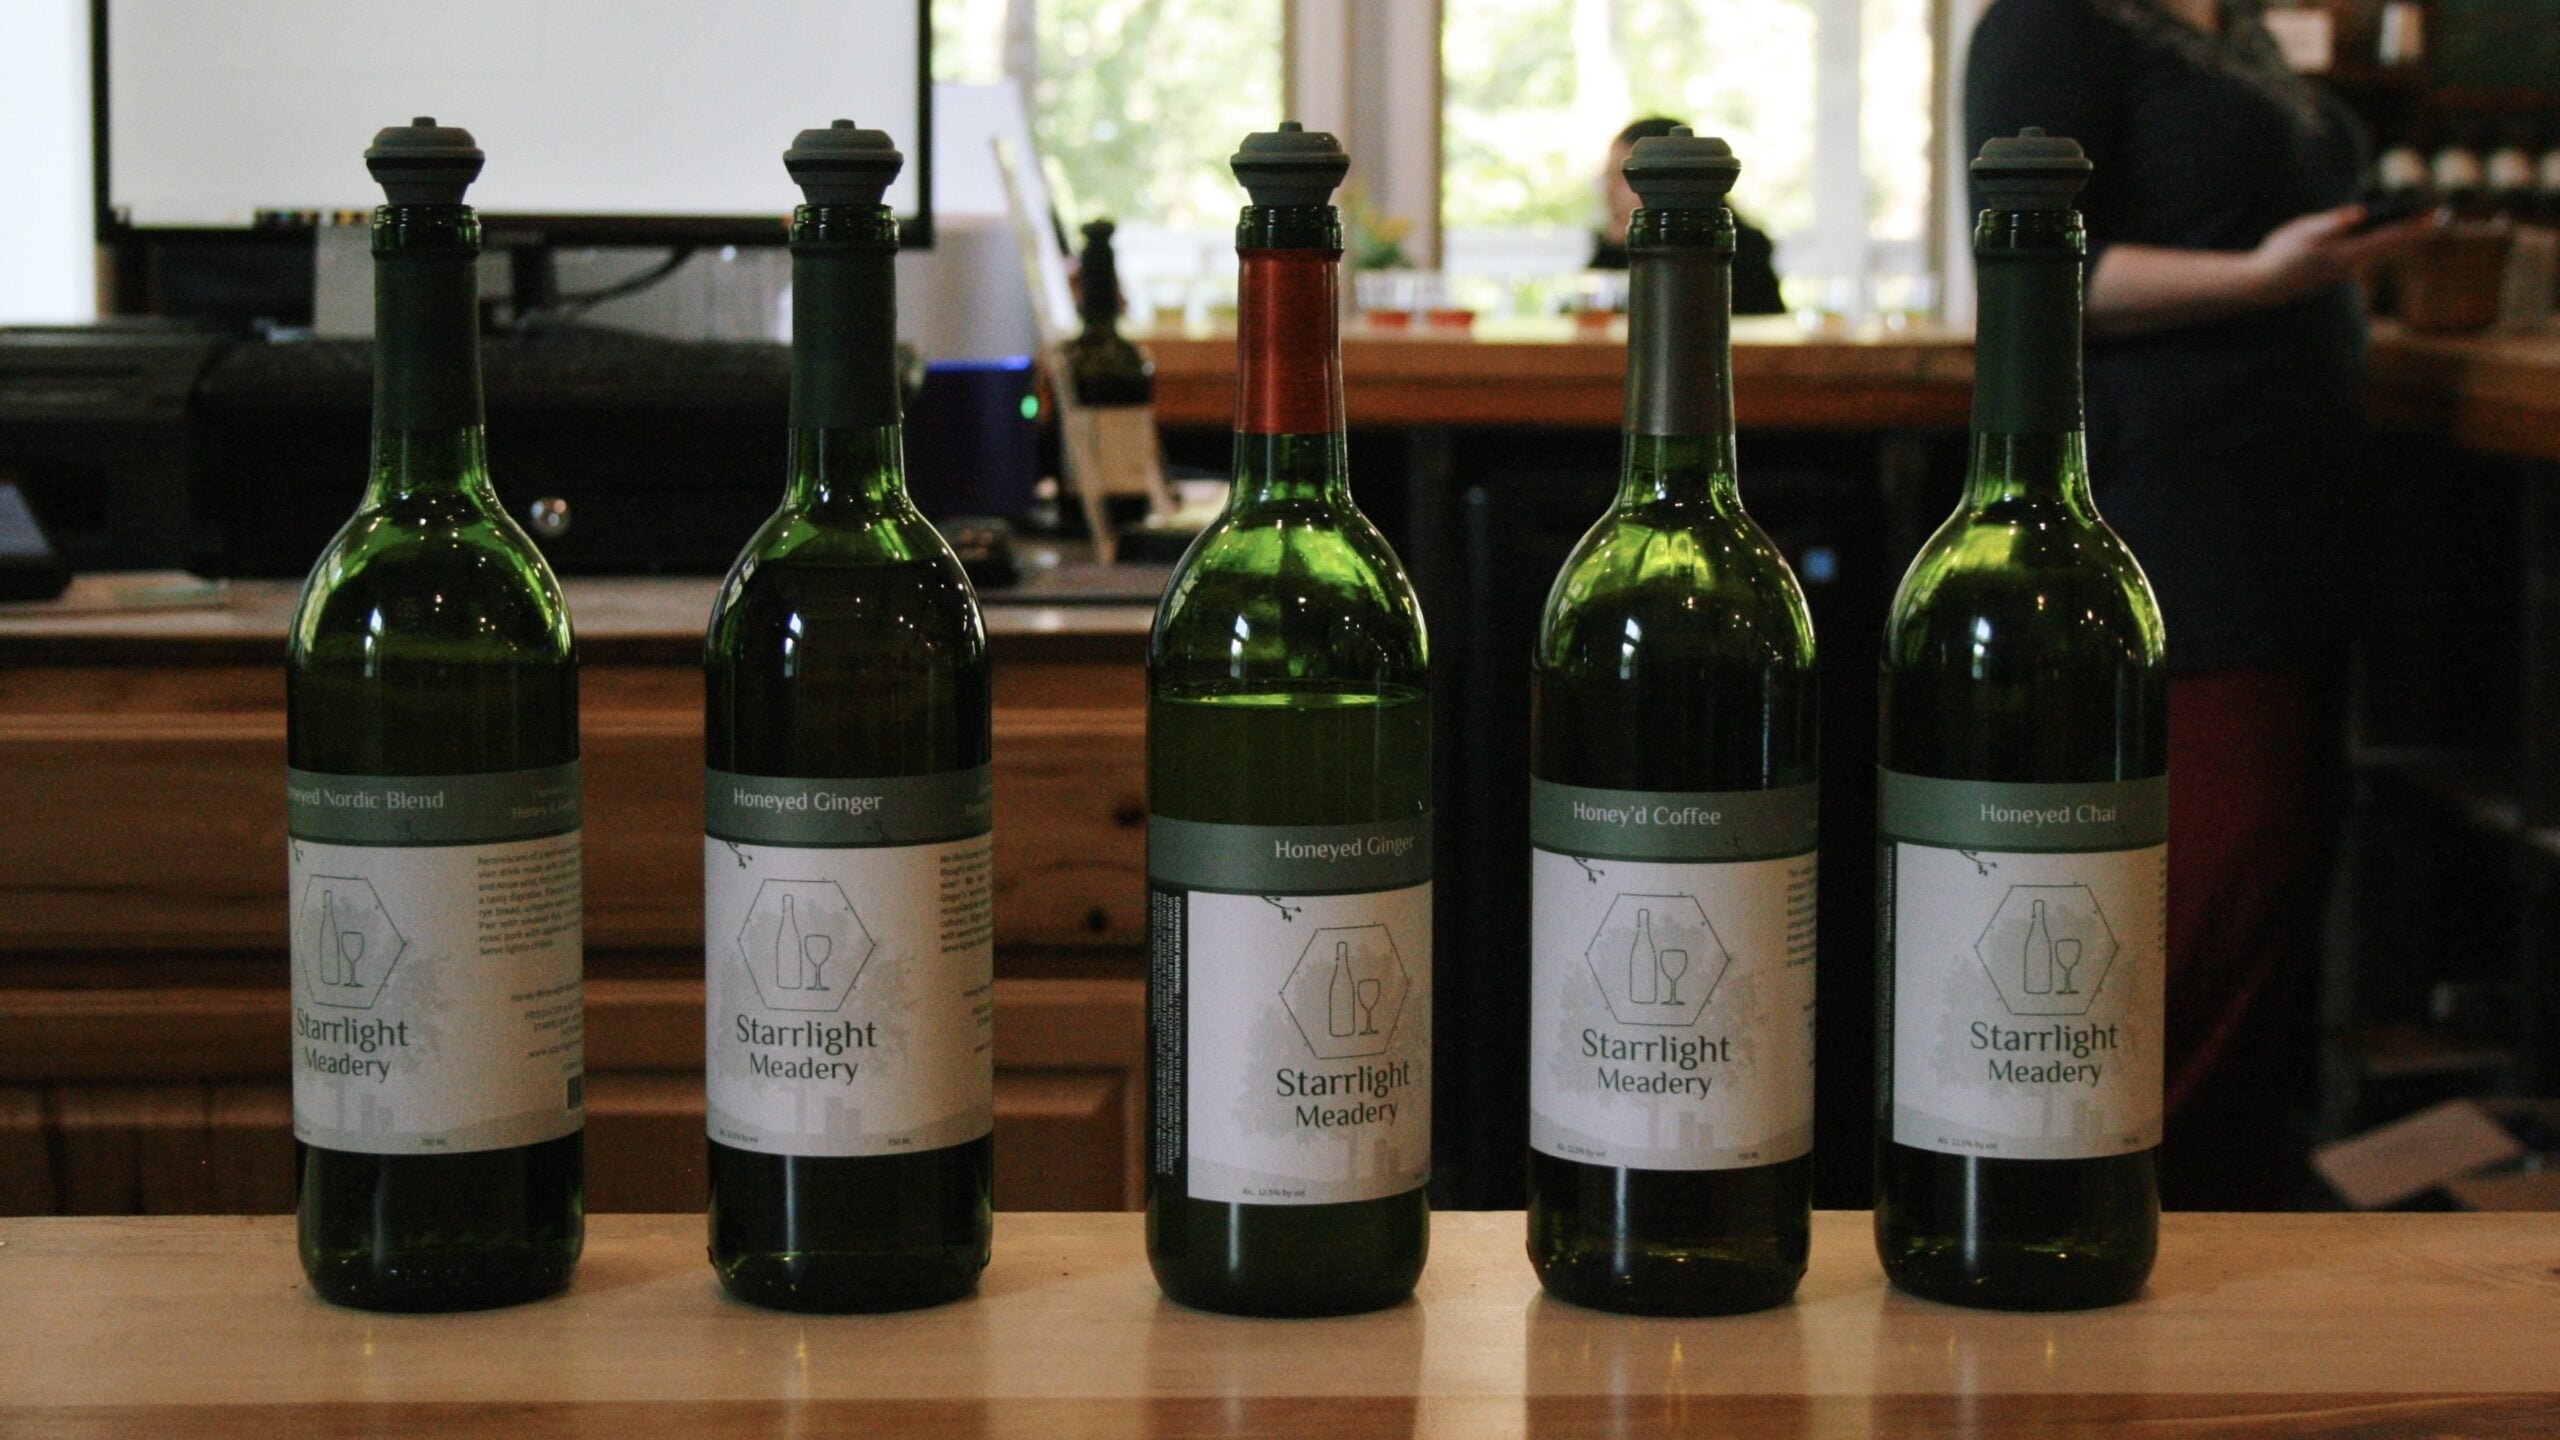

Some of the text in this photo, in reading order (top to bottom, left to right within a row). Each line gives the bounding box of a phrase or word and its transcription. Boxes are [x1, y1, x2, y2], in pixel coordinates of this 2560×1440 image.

[324, 789, 380, 809] Nordic
[387, 791, 444, 809] Blend
[734, 787, 883, 815] Honeyed Ginger
[1573, 801, 1722, 828] Honey'd Coffee
[1980, 803, 2117, 828] Honeyed Chai
[1275, 836, 1415, 862] Honeyed Ginger
[297, 1008, 411, 1053] Starrlight
[736, 1014, 878, 1056] Starrlight
[1970, 1020, 2119, 1059] Starrlight
[304, 1046, 391, 1084] Meadery
[1581, 1028, 1732, 1070] Starrlight
[750, 1052, 858, 1086] Meadery
[1276, 1061, 1410, 1099] Starrlight
[1598, 1067, 1713, 1101] Meadery
[1988, 1058, 2102, 1088] Meadery
[1295, 1101, 1400, 1128] Meadery
